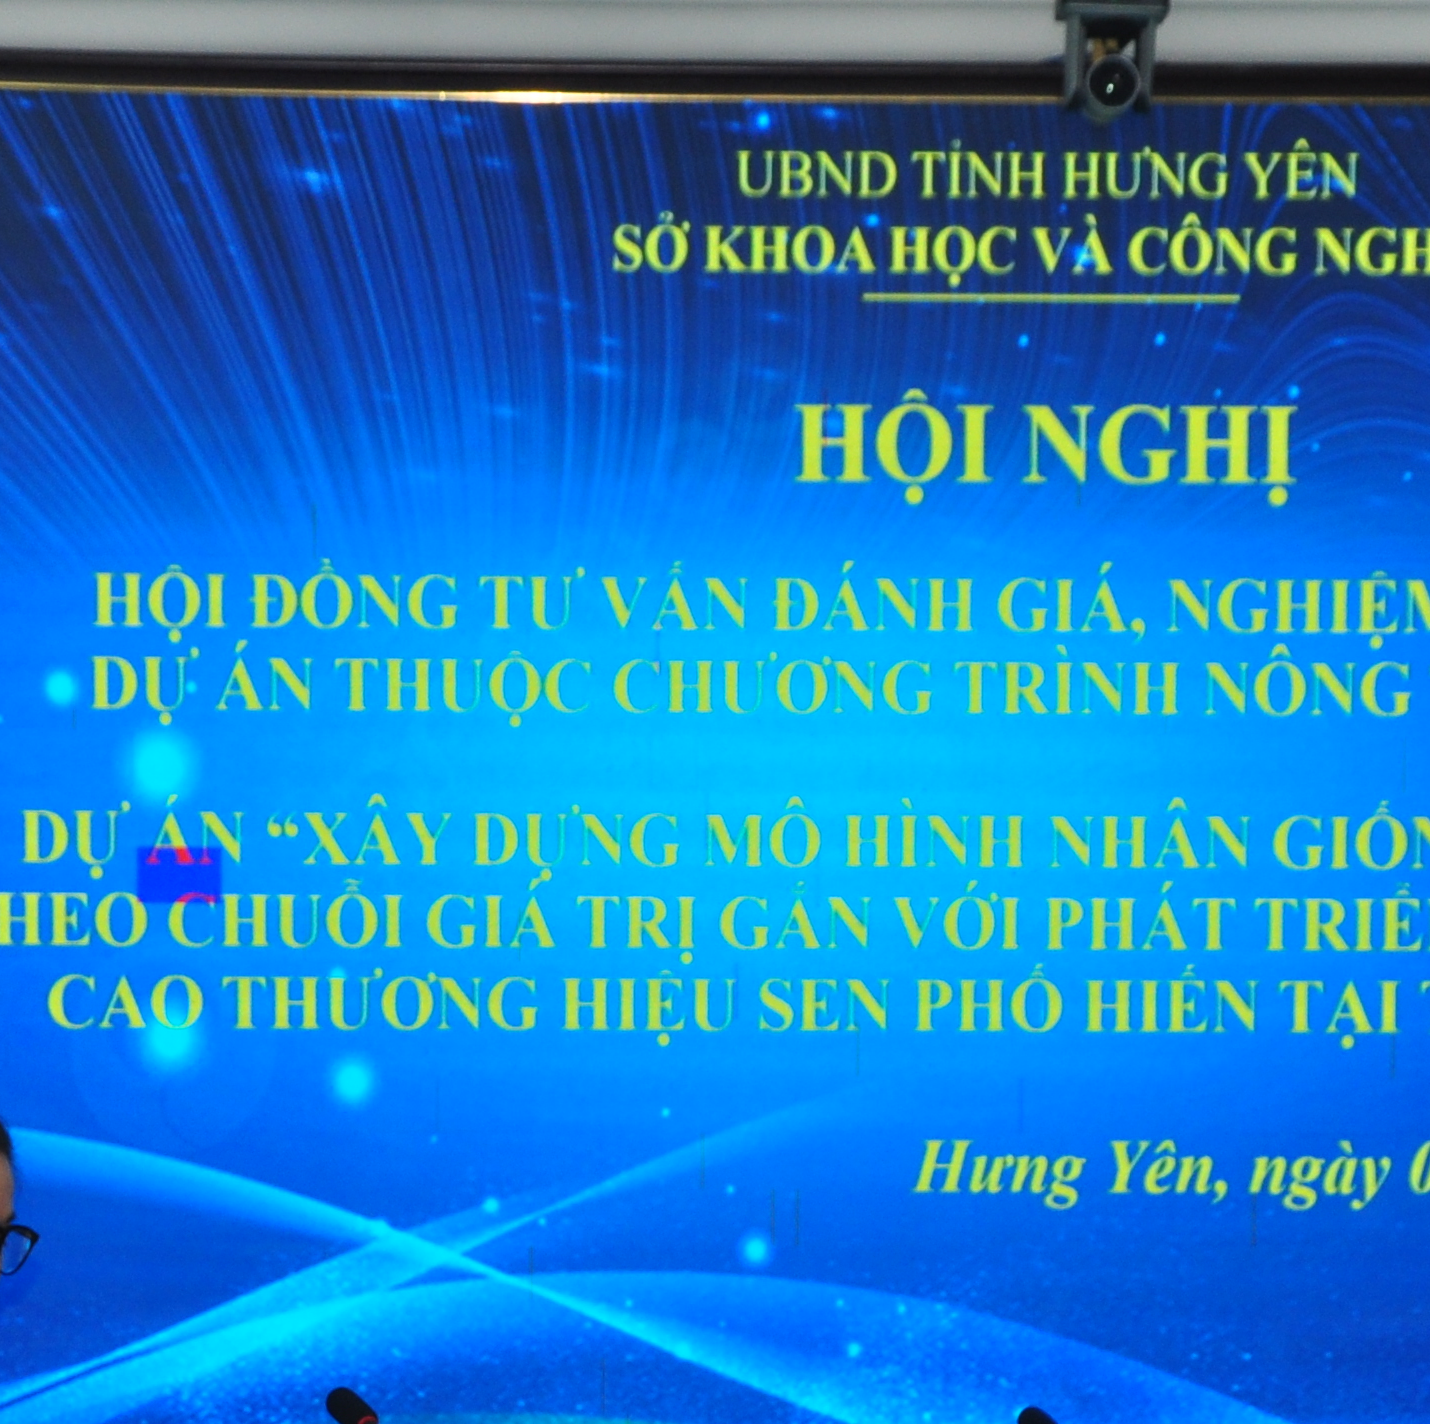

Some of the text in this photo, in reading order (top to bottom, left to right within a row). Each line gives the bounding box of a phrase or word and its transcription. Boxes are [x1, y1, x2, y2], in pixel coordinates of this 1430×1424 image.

[736, 137, 1360, 199] UBND TỈNH HƯNG YÊN
[613, 209, 691, 275] SỞ
[705, 223, 876, 275] KHOA
[890, 223, 1017, 289] HỌC
[1032, 211, 1113, 277] VÀ
[1127, 211, 1298, 277] CÔNG
[794, 386, 1298, 507] HỘI NGHỊ
[92, 563, 225, 644] HỘI
[249, 557, 458, 631] ĐỒNG
[480, 565, 586, 631] TƯ
[772, 561, 974, 633] ĐÁNH
[996, 561, 1146, 644] GIÁ,
[90, 645, 200, 726] DỰ
[215, 641, 311, 711] ÁN
[334, 651, 592, 727] THUỘC
[614, 651, 932, 715] CHƯƠNG
[955, 643, 1175, 717] TRÌNH
[1206, 643, 1412, 717] NÔNG
[22, 799, 130, 879] DỰ
[146, 793, 244, 865] ÁN
[473, 803, 678, 877] DỰNG
[704, 795, 822, 867] MÔ
[846, 797, 1023, 867] HÌNH
[1050, 797, 1250, 869] NHÂN
[167, 879, 402, 947] CHUỖI
[426, 877, 556, 949] GIÁ
[576, 895, 696, 965] TRỊ
[894, 881, 1020, 951] VỚI
[1048, 881, 1238, 951] PHÁT
[46, 973, 204, 1029] CAO
[220, 967, 538, 1031] THƯƠNG
[562, 971, 736, 1047] HIỆU
[756, 977, 892, 1033] SEN
[916, 963, 1062, 1033] PHỐ
[1086, 963, 1256, 1033] HIẾN
[1278, 979, 1400, 1051] TẠI
[913, 1137, 1085, 1211] Hưng
[1106, 1137, 1226, 1205] Yên,
[1250, 1141, 1390, 1211] ngày
